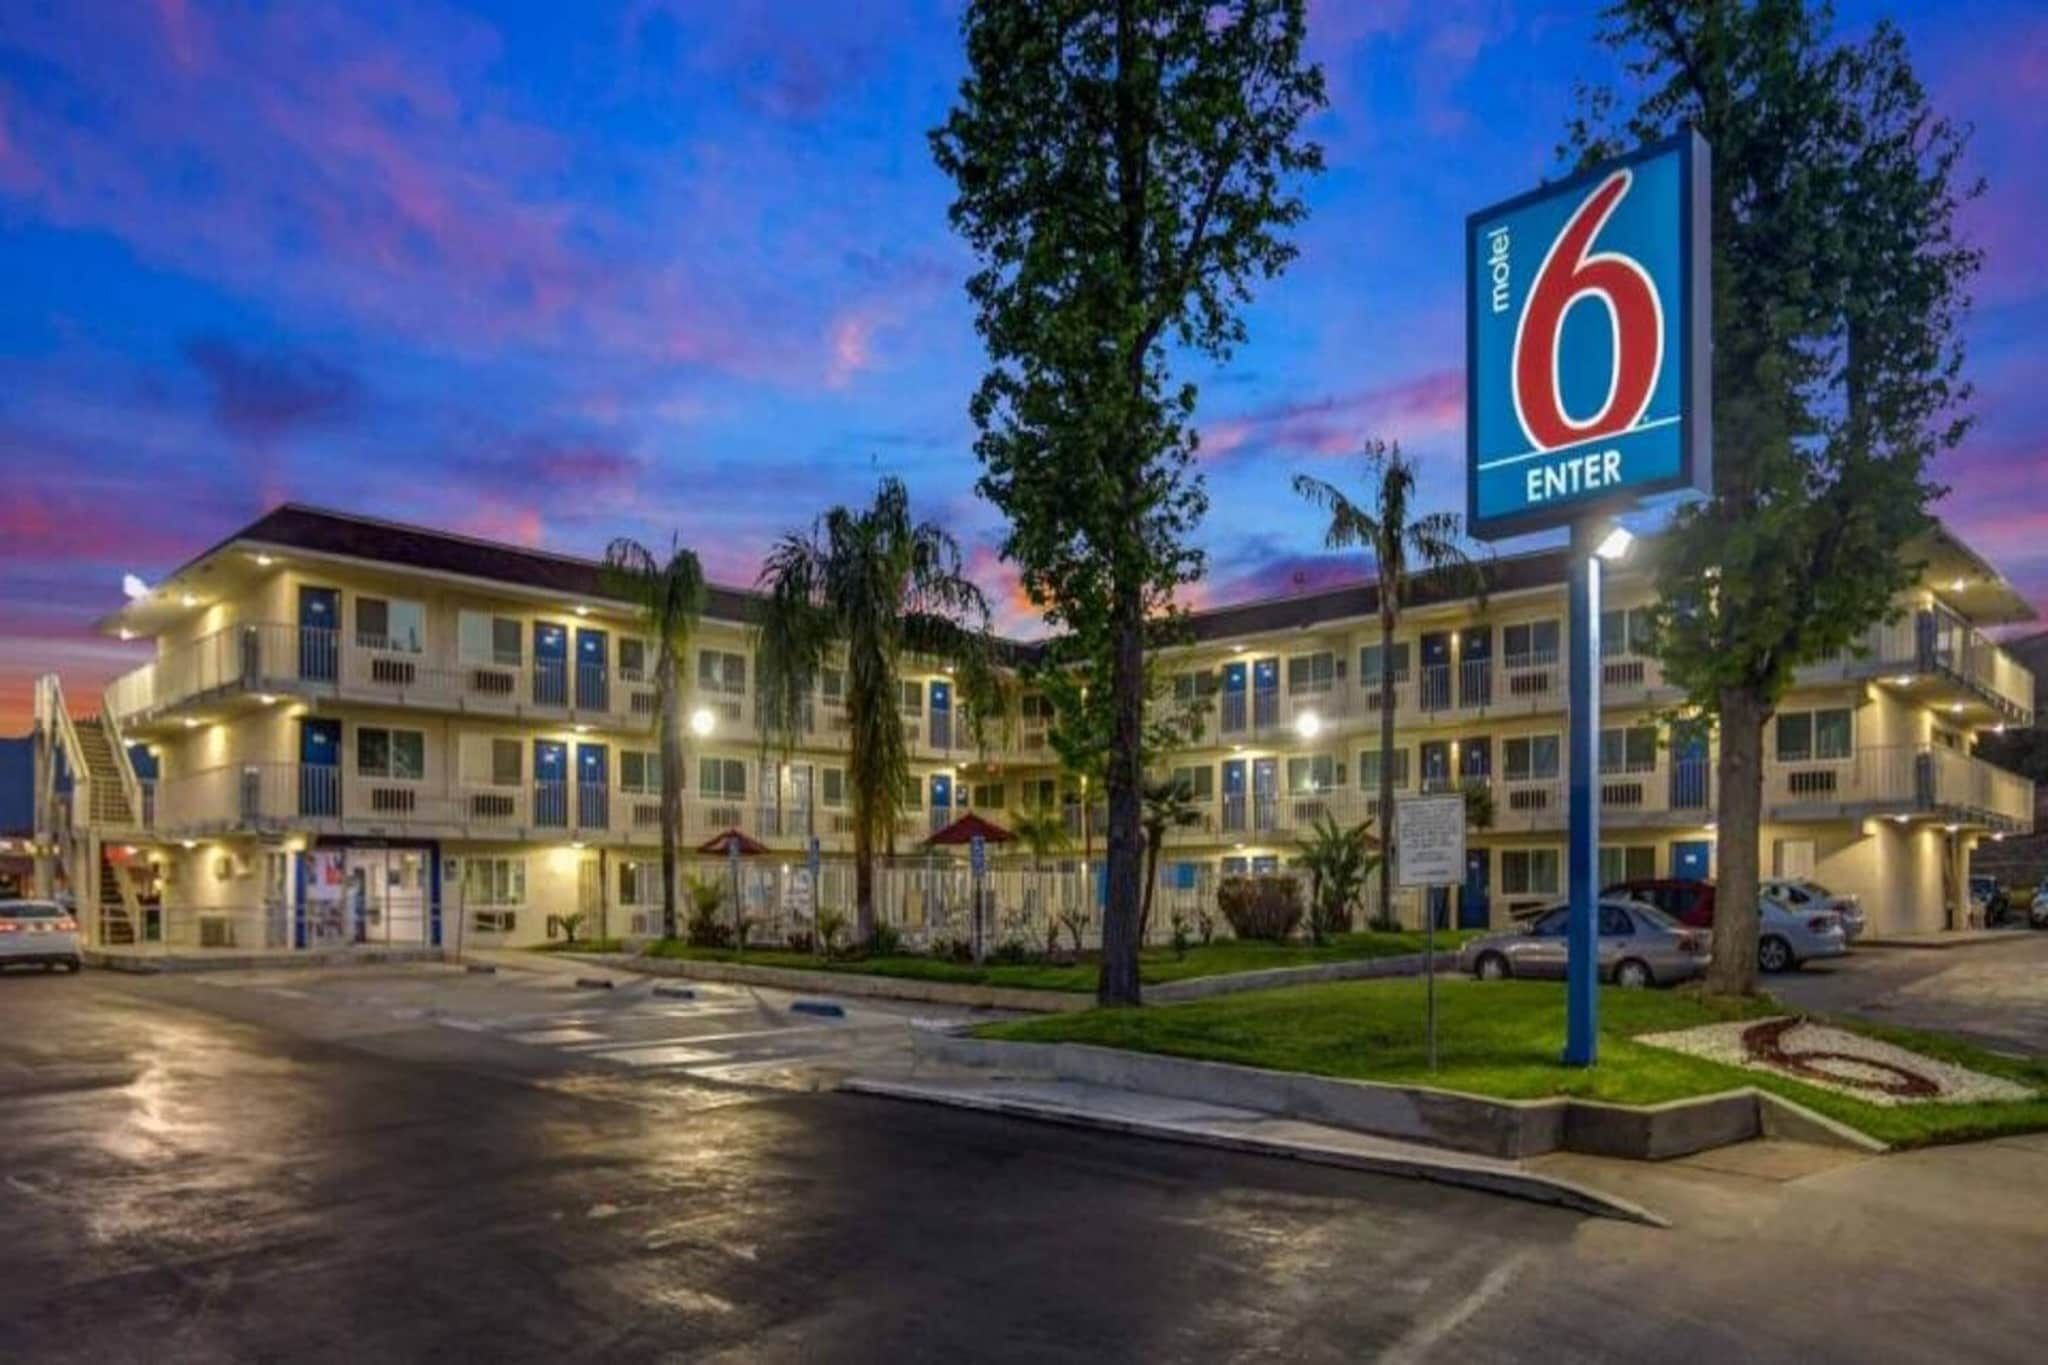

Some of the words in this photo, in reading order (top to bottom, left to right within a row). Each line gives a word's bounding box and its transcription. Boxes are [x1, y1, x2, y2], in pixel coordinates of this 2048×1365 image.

[1488, 226, 1510, 312] motel
[1512, 169, 1664, 451] 6
[1527, 450, 1621, 502] ENTER
